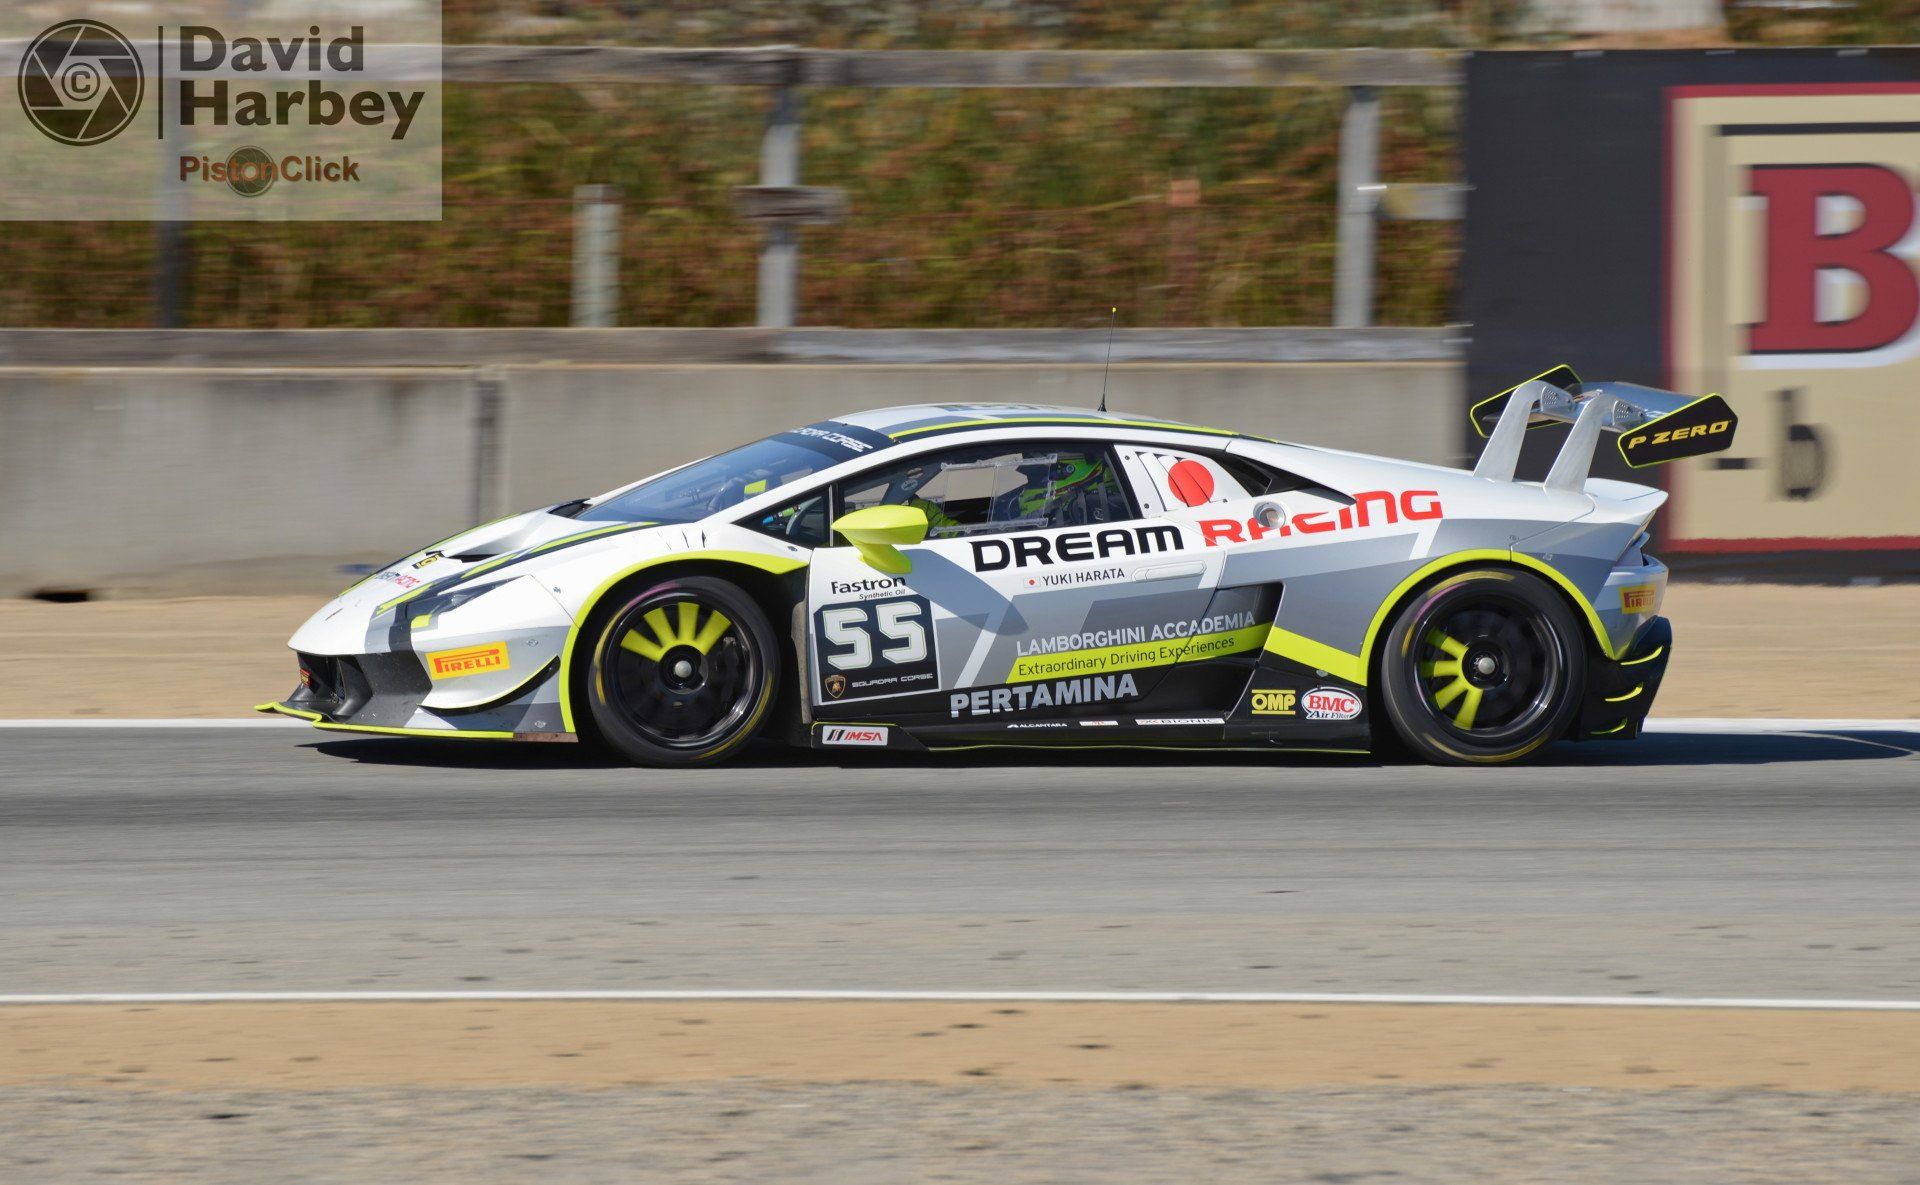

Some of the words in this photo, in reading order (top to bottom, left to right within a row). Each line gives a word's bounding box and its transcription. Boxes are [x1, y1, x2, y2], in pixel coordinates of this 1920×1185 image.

[1628, 435, 1646, 449] P
[1651, 420, 1730, 445] ZERO
[968, 525, 1184, 572] DREAM
[1195, 490, 1443, 547] RACING
[831, 576, 906, 594] Fastron
[1043, 575, 1072, 587] YUKI
[1076, 568, 1125, 583] HARATA
[859, 591, 893, 600] Synthetic
[823, 601, 927, 670] 55
[1016, 626, 1145, 657] LAMBORGHINI
[1150, 611, 1255, 641] ACCADEMIA
[434, 649, 501, 673] PIRELLI
[1018, 656, 1107, 676] Extraordinary
[1111, 650, 1155, 665] Driving
[1160, 636, 1235, 659] Experiences
[852, 677, 898, 688] SQUADRA
[901, 673, 933, 682] CORSE
[950, 673, 1139, 718] PERTAMINA
[1252, 694, 1296, 711] OMP
[1308, 695, 1355, 713] BMC
[1309, 710, 1328, 718] Air
[844, 731, 883, 741] IMSA
